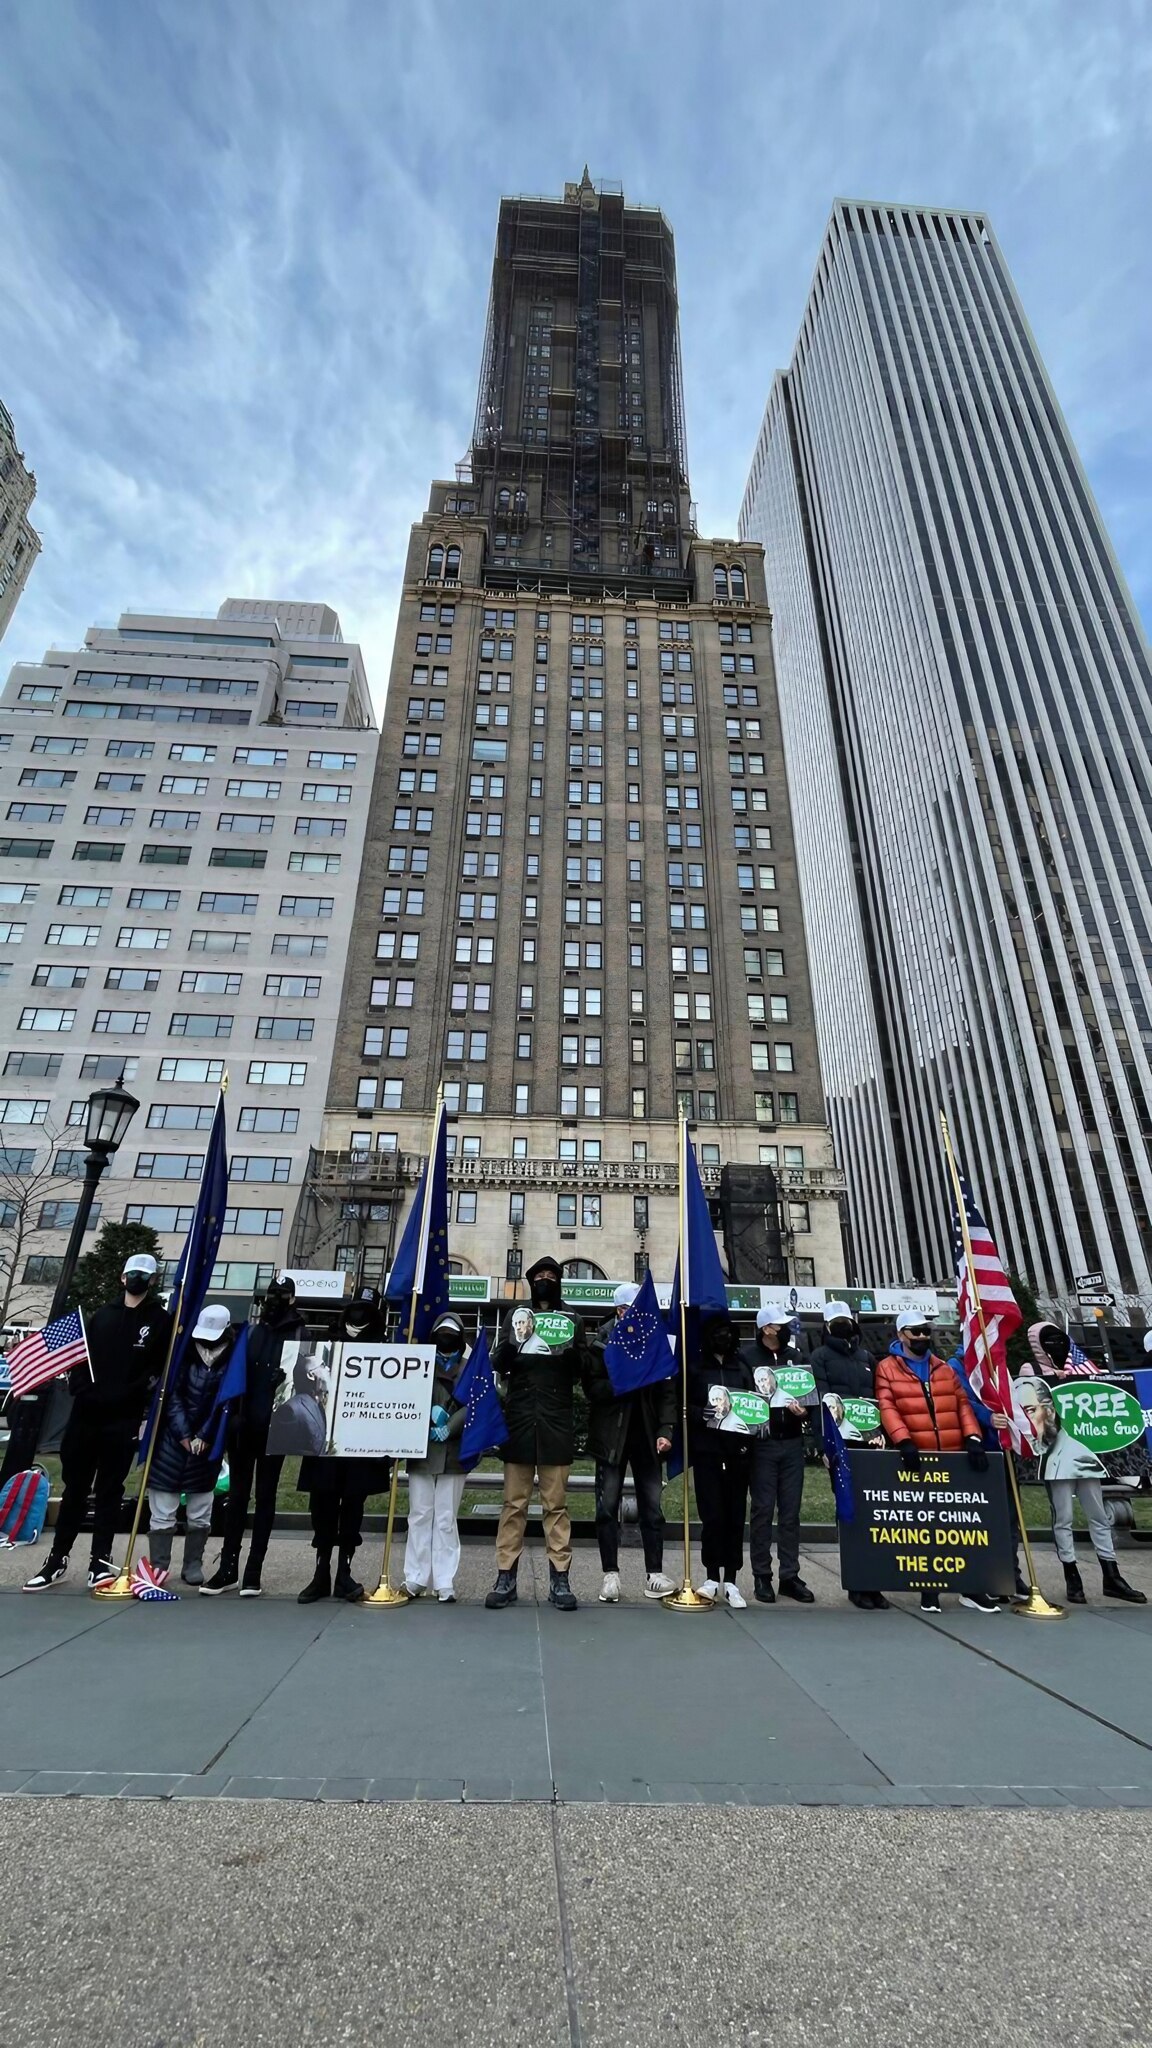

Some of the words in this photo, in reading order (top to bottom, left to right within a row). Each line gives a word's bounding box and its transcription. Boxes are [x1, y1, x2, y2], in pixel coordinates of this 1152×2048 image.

[882, 1303, 934, 1312] DELVAUX
[535, 1317, 568, 1330] FREE
[344, 1356, 430, 1379] STOP!
[775, 1372, 808, 1383] FREE
[343, 1401, 415, 1410] PERSECUTION
[731, 1395, 764, 1411] FREE
[843, 1403, 876, 1417] FREE
[1056, 1392, 1130, 1419] FREE
[342, 1411, 356, 1419] OF
[359, 1411, 391, 1420] MILES
[1073, 1422, 1109, 1436] Miles
[1114, 1420, 1140, 1435] Guo
[897, 1471, 920, 1482] WE
[923, 1472, 950, 1483] ARE
[863, 1490, 890, 1502] THE
[893, 1491, 924, 1503] NEW
[928, 1492, 989, 1504] FEDERAL
[873, 1509, 914, 1522] STATE
[917, 1510, 936, 1522] OF
[938, 1511, 982, 1523] CHINA
[869, 1527, 931, 1545] TAKING
[935, 1529, 989, 1546] DOWN
[896, 1556, 929, 1572] THE
[932, 1557, 966, 1573] CCP
